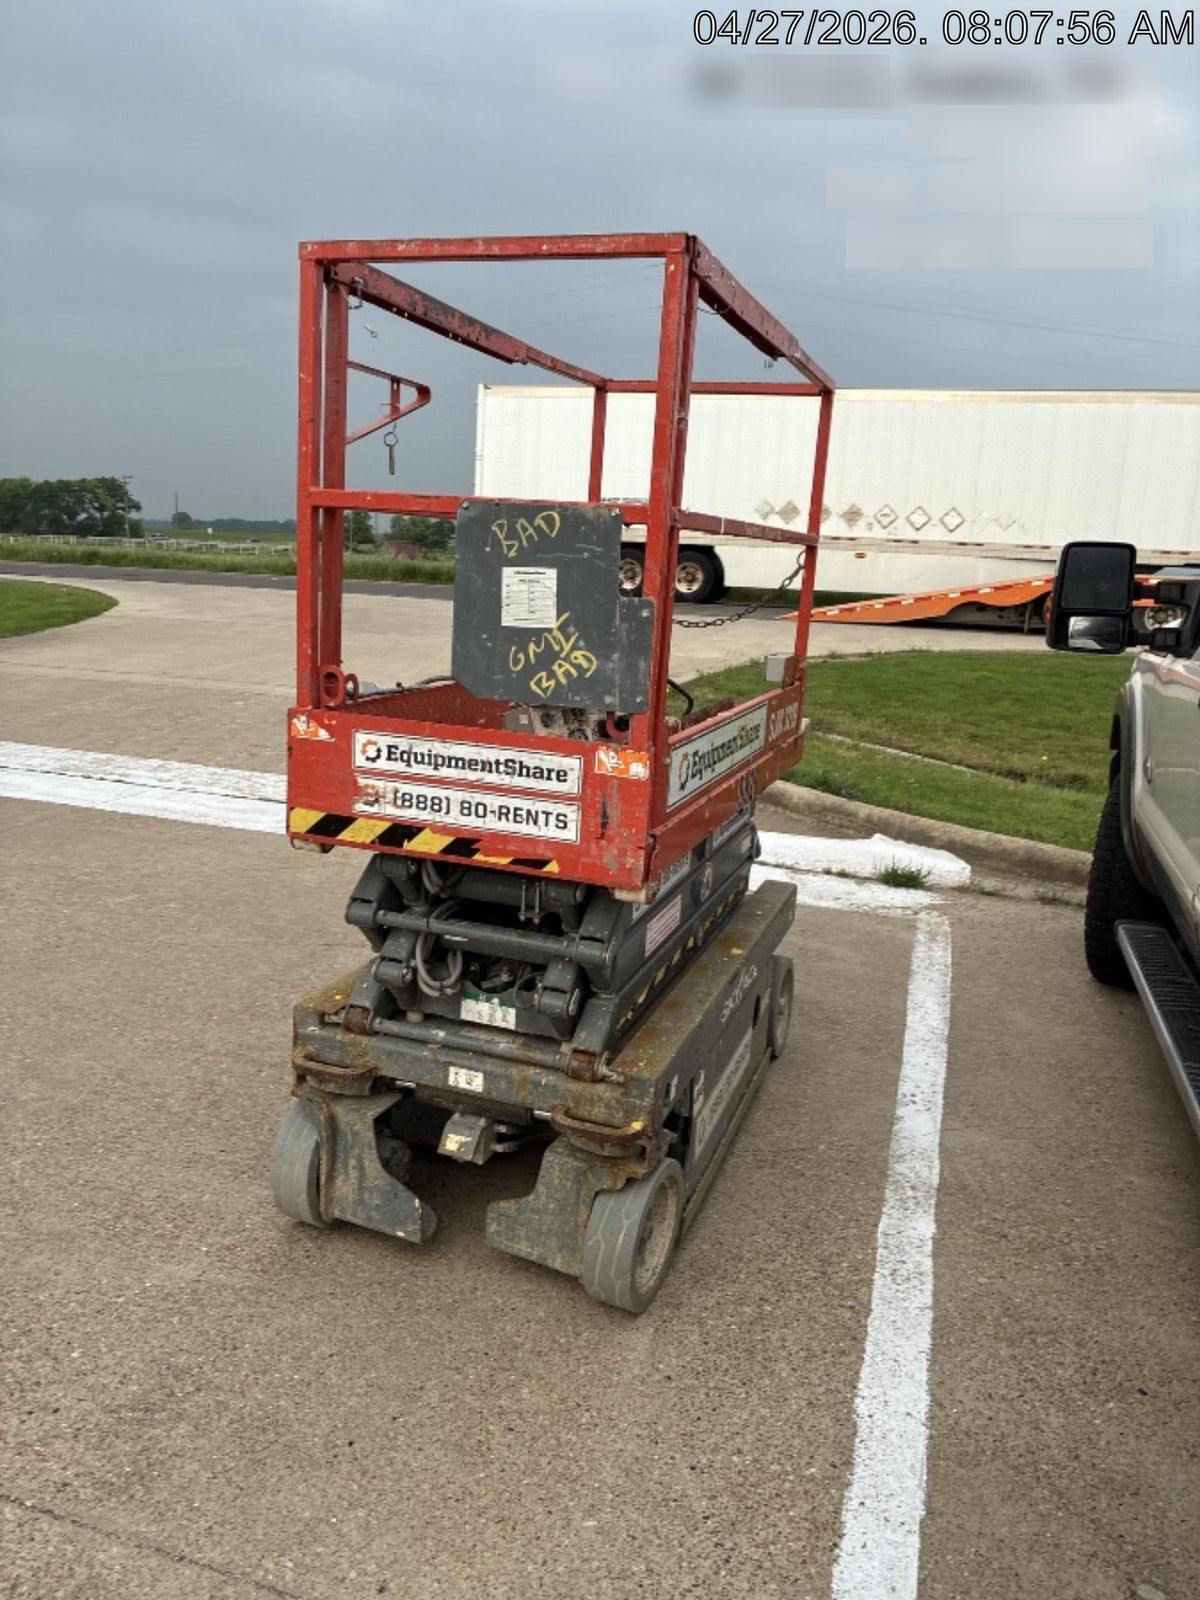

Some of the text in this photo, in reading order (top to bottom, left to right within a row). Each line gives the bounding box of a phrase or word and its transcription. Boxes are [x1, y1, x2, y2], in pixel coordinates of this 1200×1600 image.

[492, 511, 560, 558] BAD
[529, 650, 598, 699] BAD
[385, 744, 569, 783] EquipmentShare
[394, 786, 568, 830] (888) 80-RENTS
